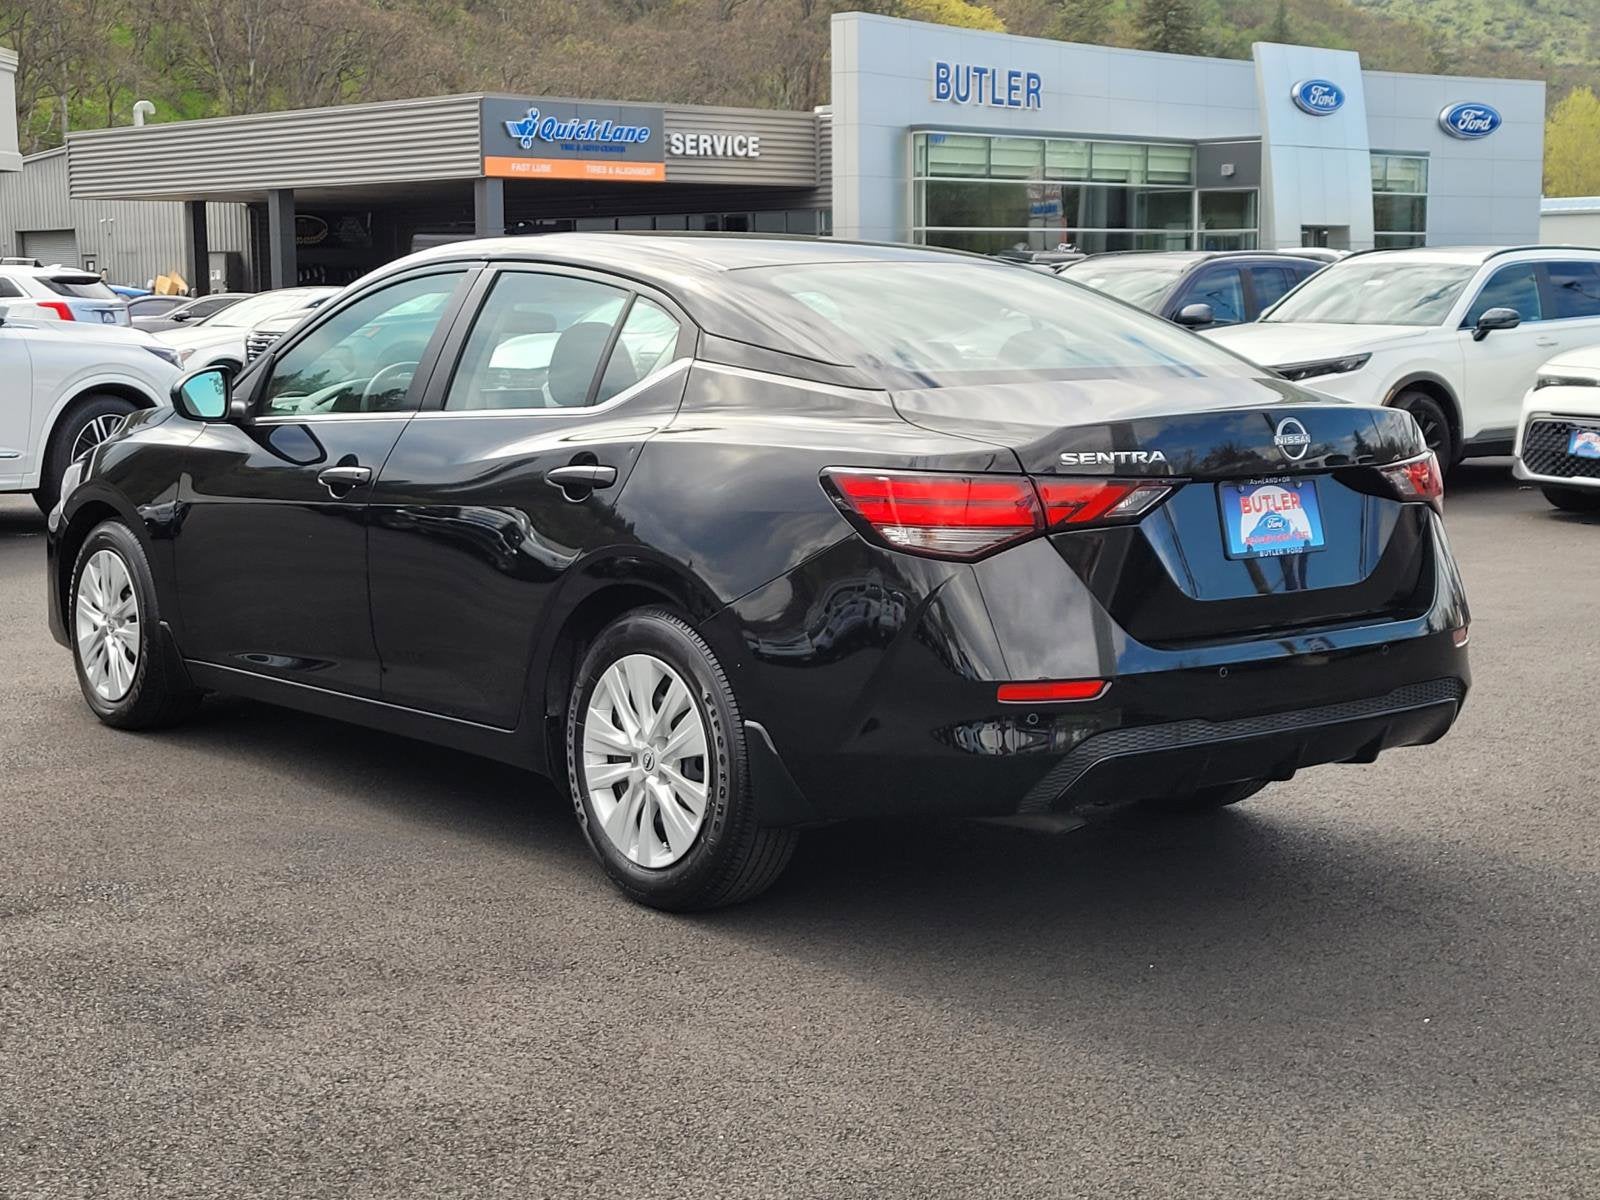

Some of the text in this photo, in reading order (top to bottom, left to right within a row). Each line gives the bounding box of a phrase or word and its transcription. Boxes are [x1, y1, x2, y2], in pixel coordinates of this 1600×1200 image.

[935, 60, 1042, 110] BUTLER
[1309, 85, 1337, 107] Ford
[539, 117, 651, 143] Quick Lane
[1457, 109, 1492, 132] Ford
[670, 132, 760, 157] SERVICE
[511, 163, 552, 173] FAST LUBE
[586, 164, 607, 174] TIRES
[614, 166, 656, 176] ALIGNMENT
[1274, 433, 1311, 446] NISSAN
[1060, 450, 1167, 466] SENTRA
[1240, 492, 1300, 515] BUTLER
[1266, 517, 1284, 529] Ford
